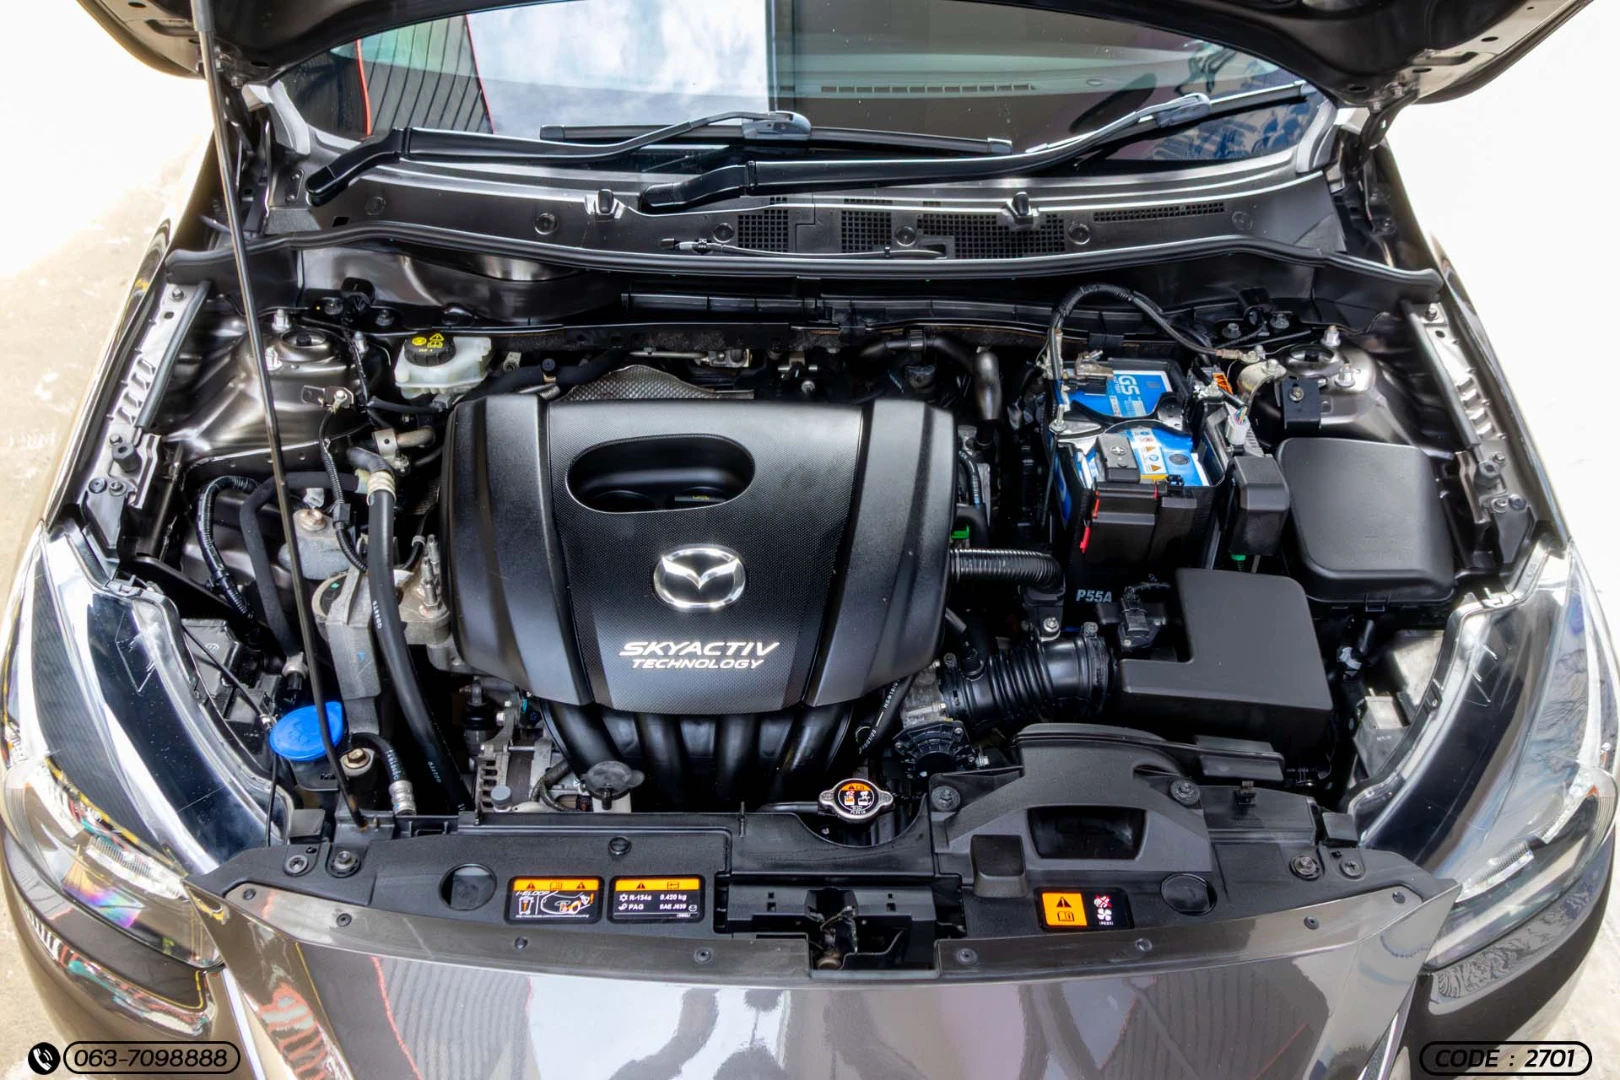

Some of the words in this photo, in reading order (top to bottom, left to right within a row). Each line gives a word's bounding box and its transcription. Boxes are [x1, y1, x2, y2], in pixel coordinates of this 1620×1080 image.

[1076, 589, 1112, 603] P55A
[619, 641, 780, 656] SKYACTIV
[632, 658, 764, 669] TECHNOLOGY
